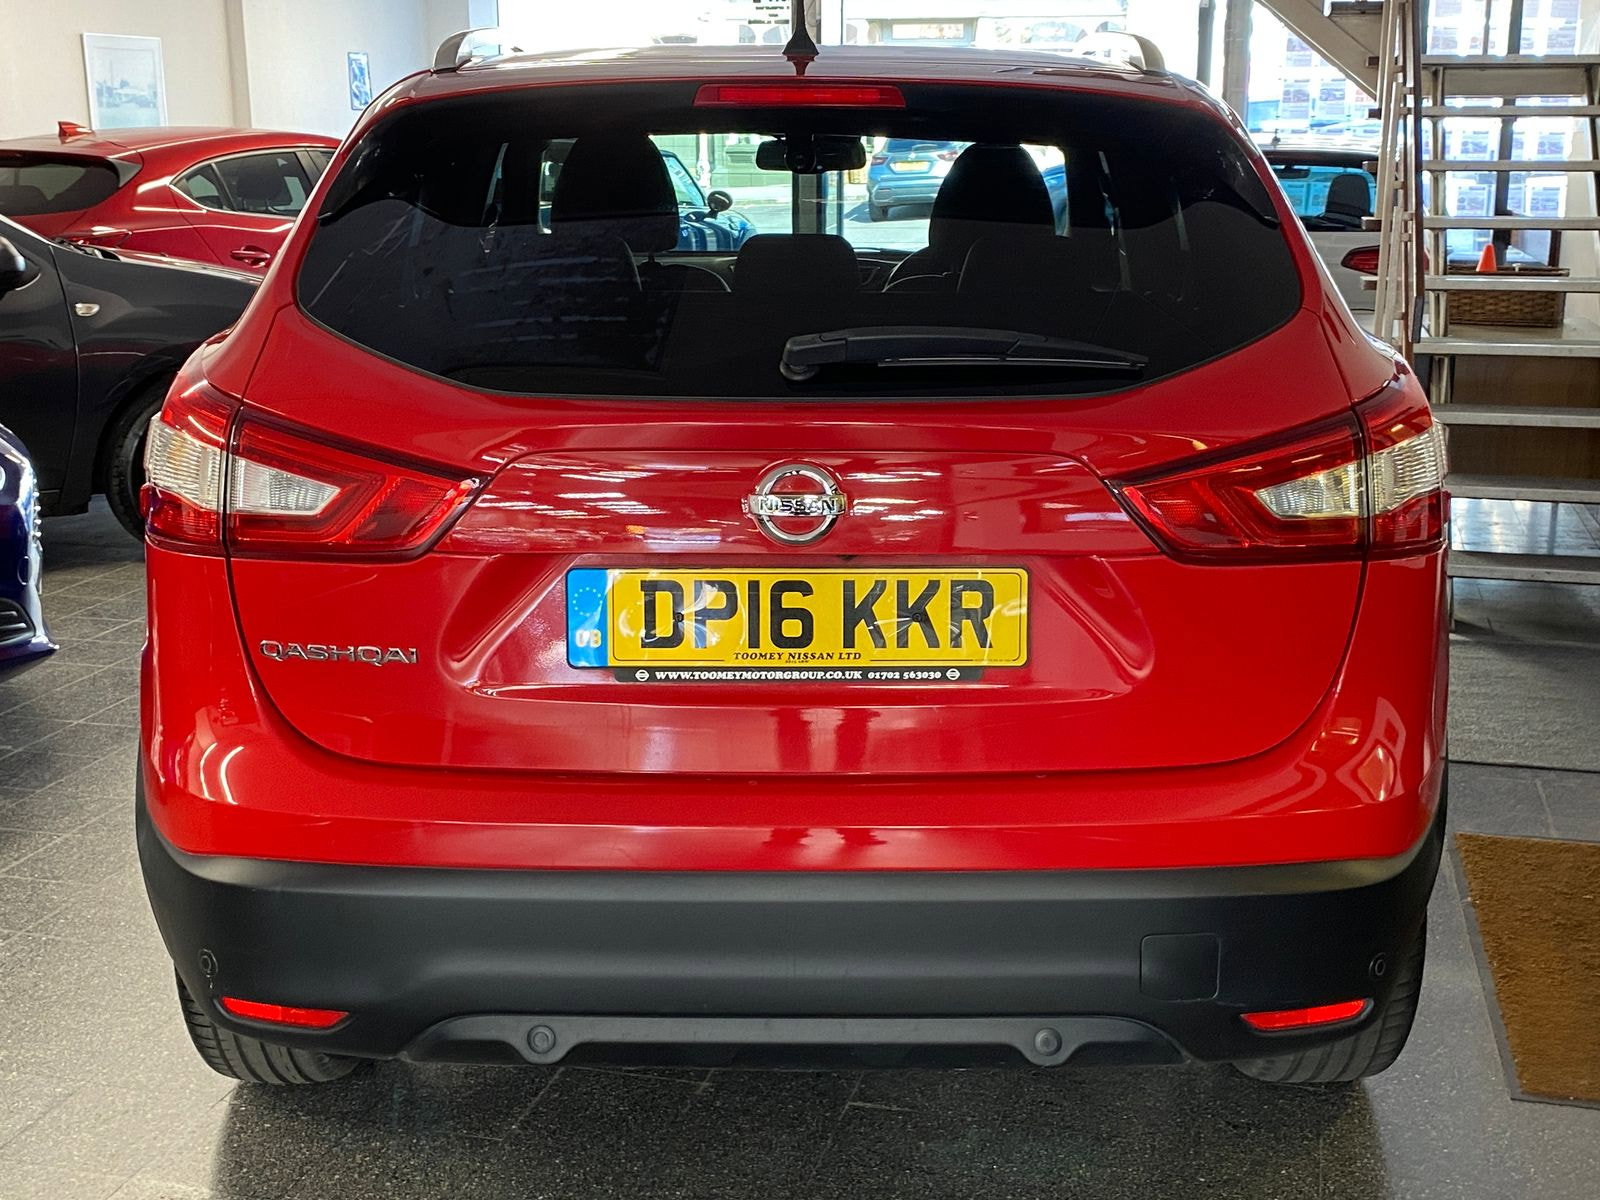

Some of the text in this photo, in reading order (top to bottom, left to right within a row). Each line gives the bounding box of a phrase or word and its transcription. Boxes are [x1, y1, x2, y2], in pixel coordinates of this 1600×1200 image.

[758, 496, 839, 513] NISSAN
[640, 580, 995, 648] DP16 KKR
[260, 640, 418, 666] QASHQAI
[733, 652, 863, 661] TOOMEY NISSAN LTD
[655, 671, 942, 681] WWW.TOOMEYMOTORGROUP.CO.UK 01702 563030
